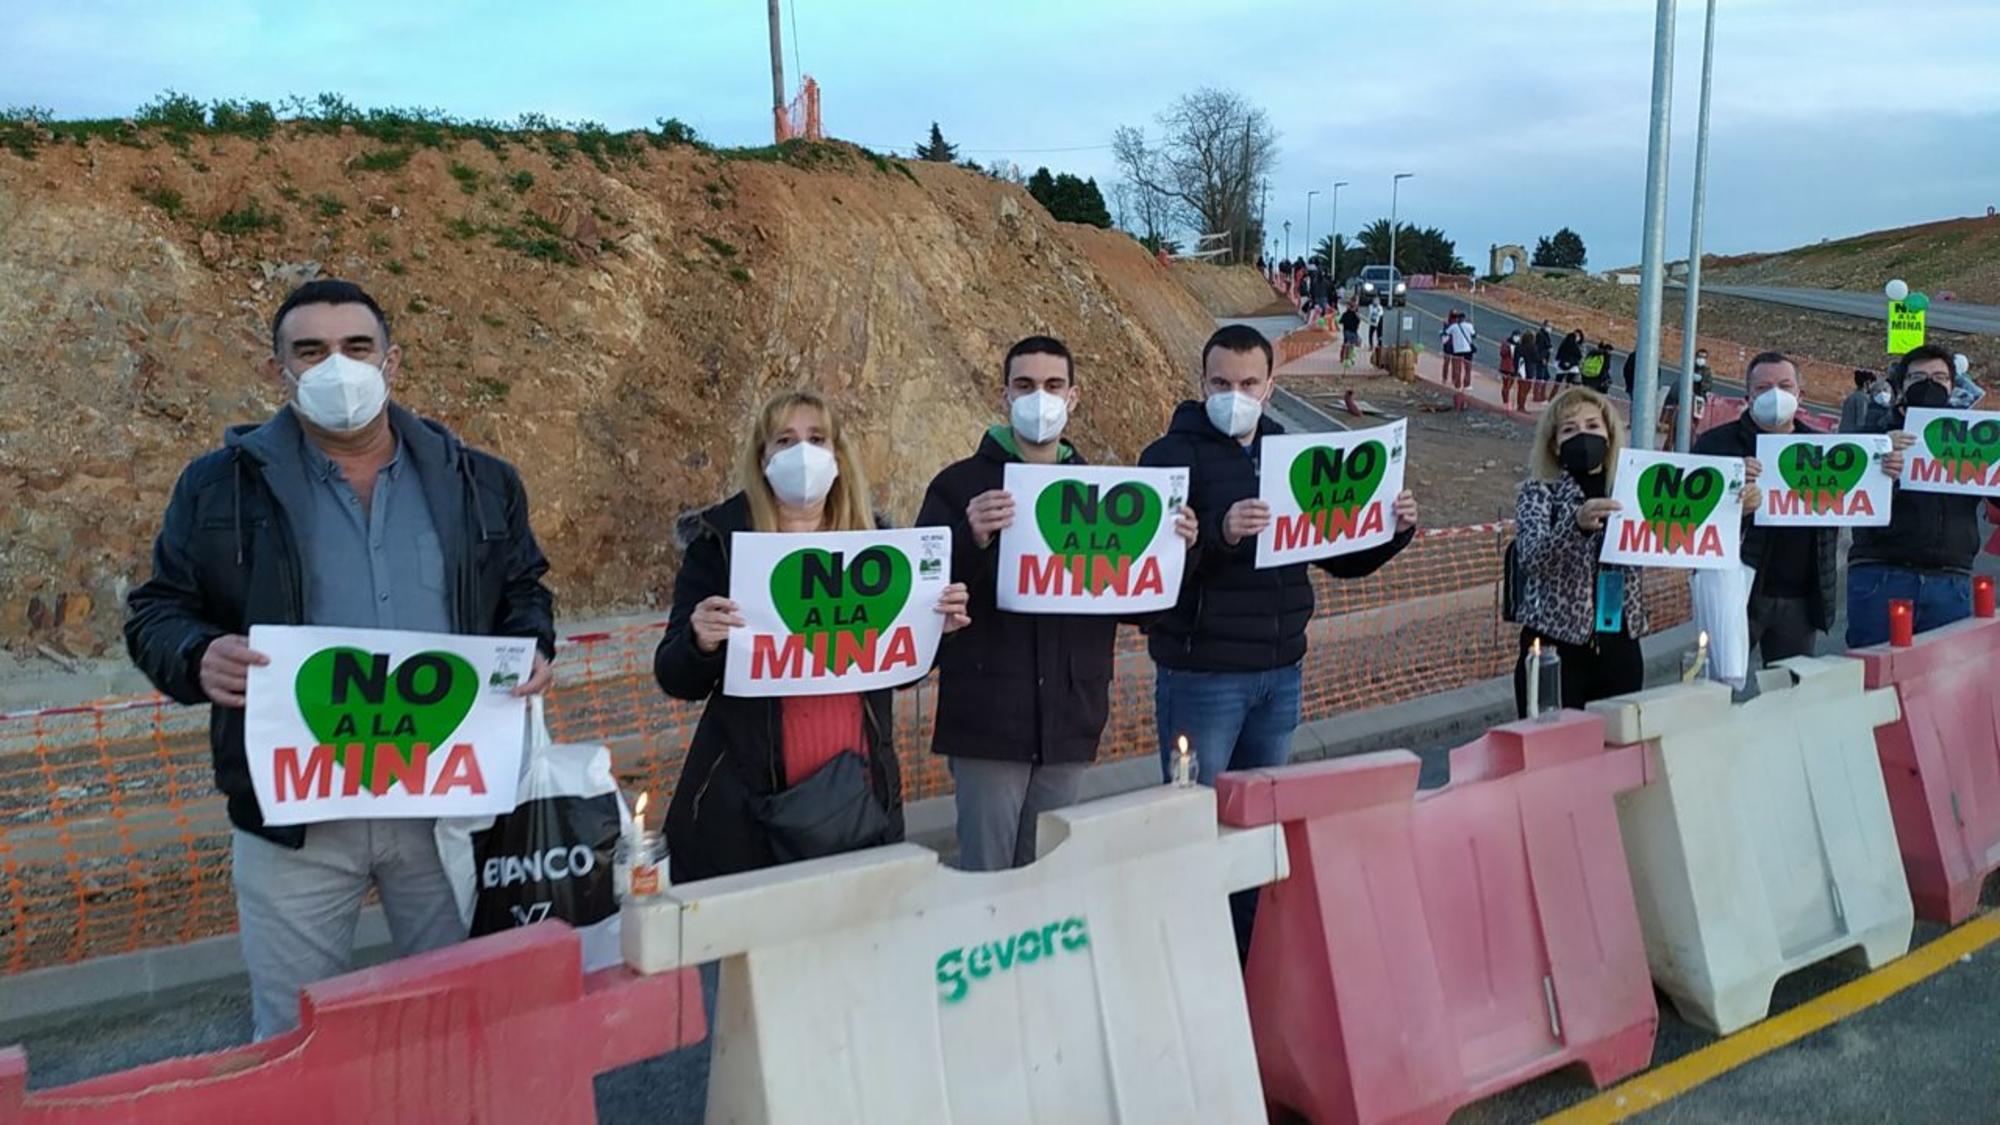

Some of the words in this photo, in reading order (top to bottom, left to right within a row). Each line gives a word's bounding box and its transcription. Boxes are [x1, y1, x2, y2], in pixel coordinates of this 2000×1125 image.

[1891, 321, 1921, 331] MINA
[1941, 419, 2000, 445] NO
[1310, 442, 1376, 487] NO
[1795, 443, 1855, 472] NO
[1942, 446, 1954, 457] A
[1961, 447, 1982, 459] LA
[1653, 466, 1714, 500] NO
[1799, 475, 1810, 487] A
[1816, 475, 1838, 487] LA
[1060, 483, 1145, 526] NO
[1310, 491, 1325, 509] A
[1331, 486, 1356, 505] LA
[1653, 503, 1664, 518] A
[1670, 504, 1691, 518] LA
[1768, 489, 1875, 516] MINA
[1063, 532, 1079, 550] A
[1089, 532, 1121, 550] LA
[1273, 501, 1384, 552] MINA
[1618, 519, 1725, 557] MINA
[800, 549, 893, 600] NO
[1017, 554, 1164, 597] MINA
[803, 606, 822, 628] A
[833, 604, 868, 626] LA
[750, 626, 918, 680] MINA
[331, 652, 454, 706] NO
[334, 713, 357, 738] A
[372, 714, 417, 737] LA
[273, 743, 488, 803] MINA
